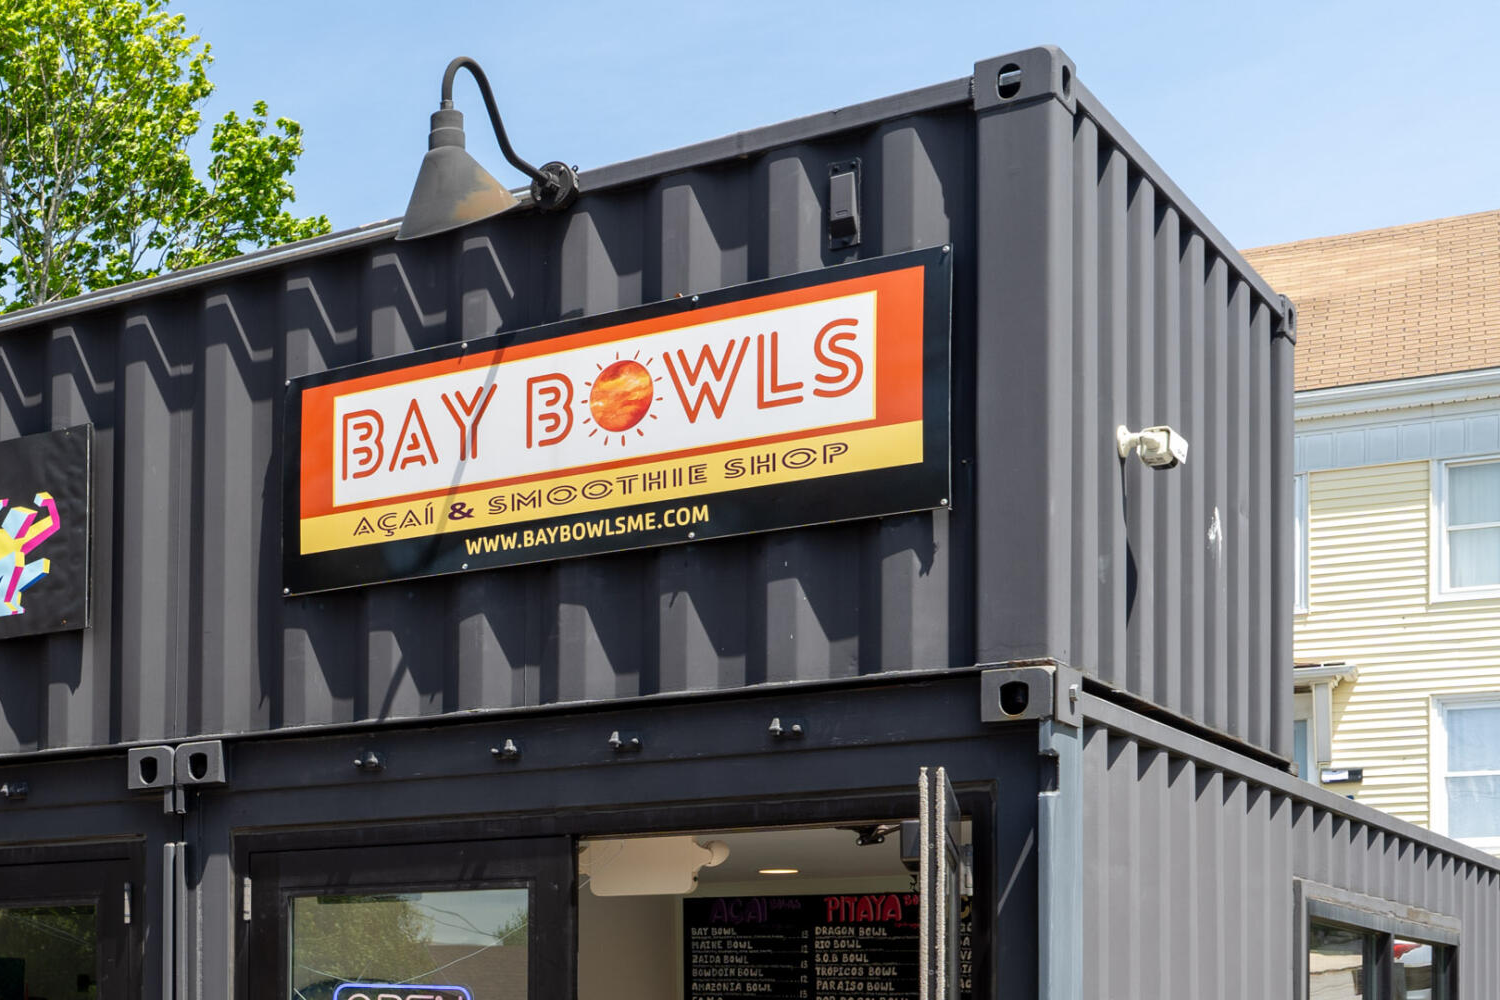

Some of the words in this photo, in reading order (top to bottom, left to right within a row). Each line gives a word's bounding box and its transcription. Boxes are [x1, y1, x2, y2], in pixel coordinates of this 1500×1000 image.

[342, 382, 498, 482] BAY
[525, 317, 866, 449] BOWLS
[353, 502, 435, 538] AÇAÍ
[447, 501, 475, 521] &
[487, 463, 709, 516] SMOOTHIE
[723, 442, 850, 479] SHOP
[464, 503, 710, 557] WWW.BAYBOWLSME.COM
[823, 894, 902, 923] PITAYA
[691, 927, 708, 936] BAY
[711, 927, 737, 936] BOWL
[814, 926, 855, 936] DRAGON
[858, 927, 887, 937] BOWL
[726, 941, 753, 950] BOWL
[814, 940, 831, 949] RIO
[833, 941, 862, 949] BOWL
[723, 955, 749, 965] BOWL
[841, 953, 869, 963] BOWL
[737, 968, 764, 977] BOWL
[868, 966, 898, 976] BOWL
[746, 983, 772, 992] BOWL
[866, 981, 895, 992] BOWL
